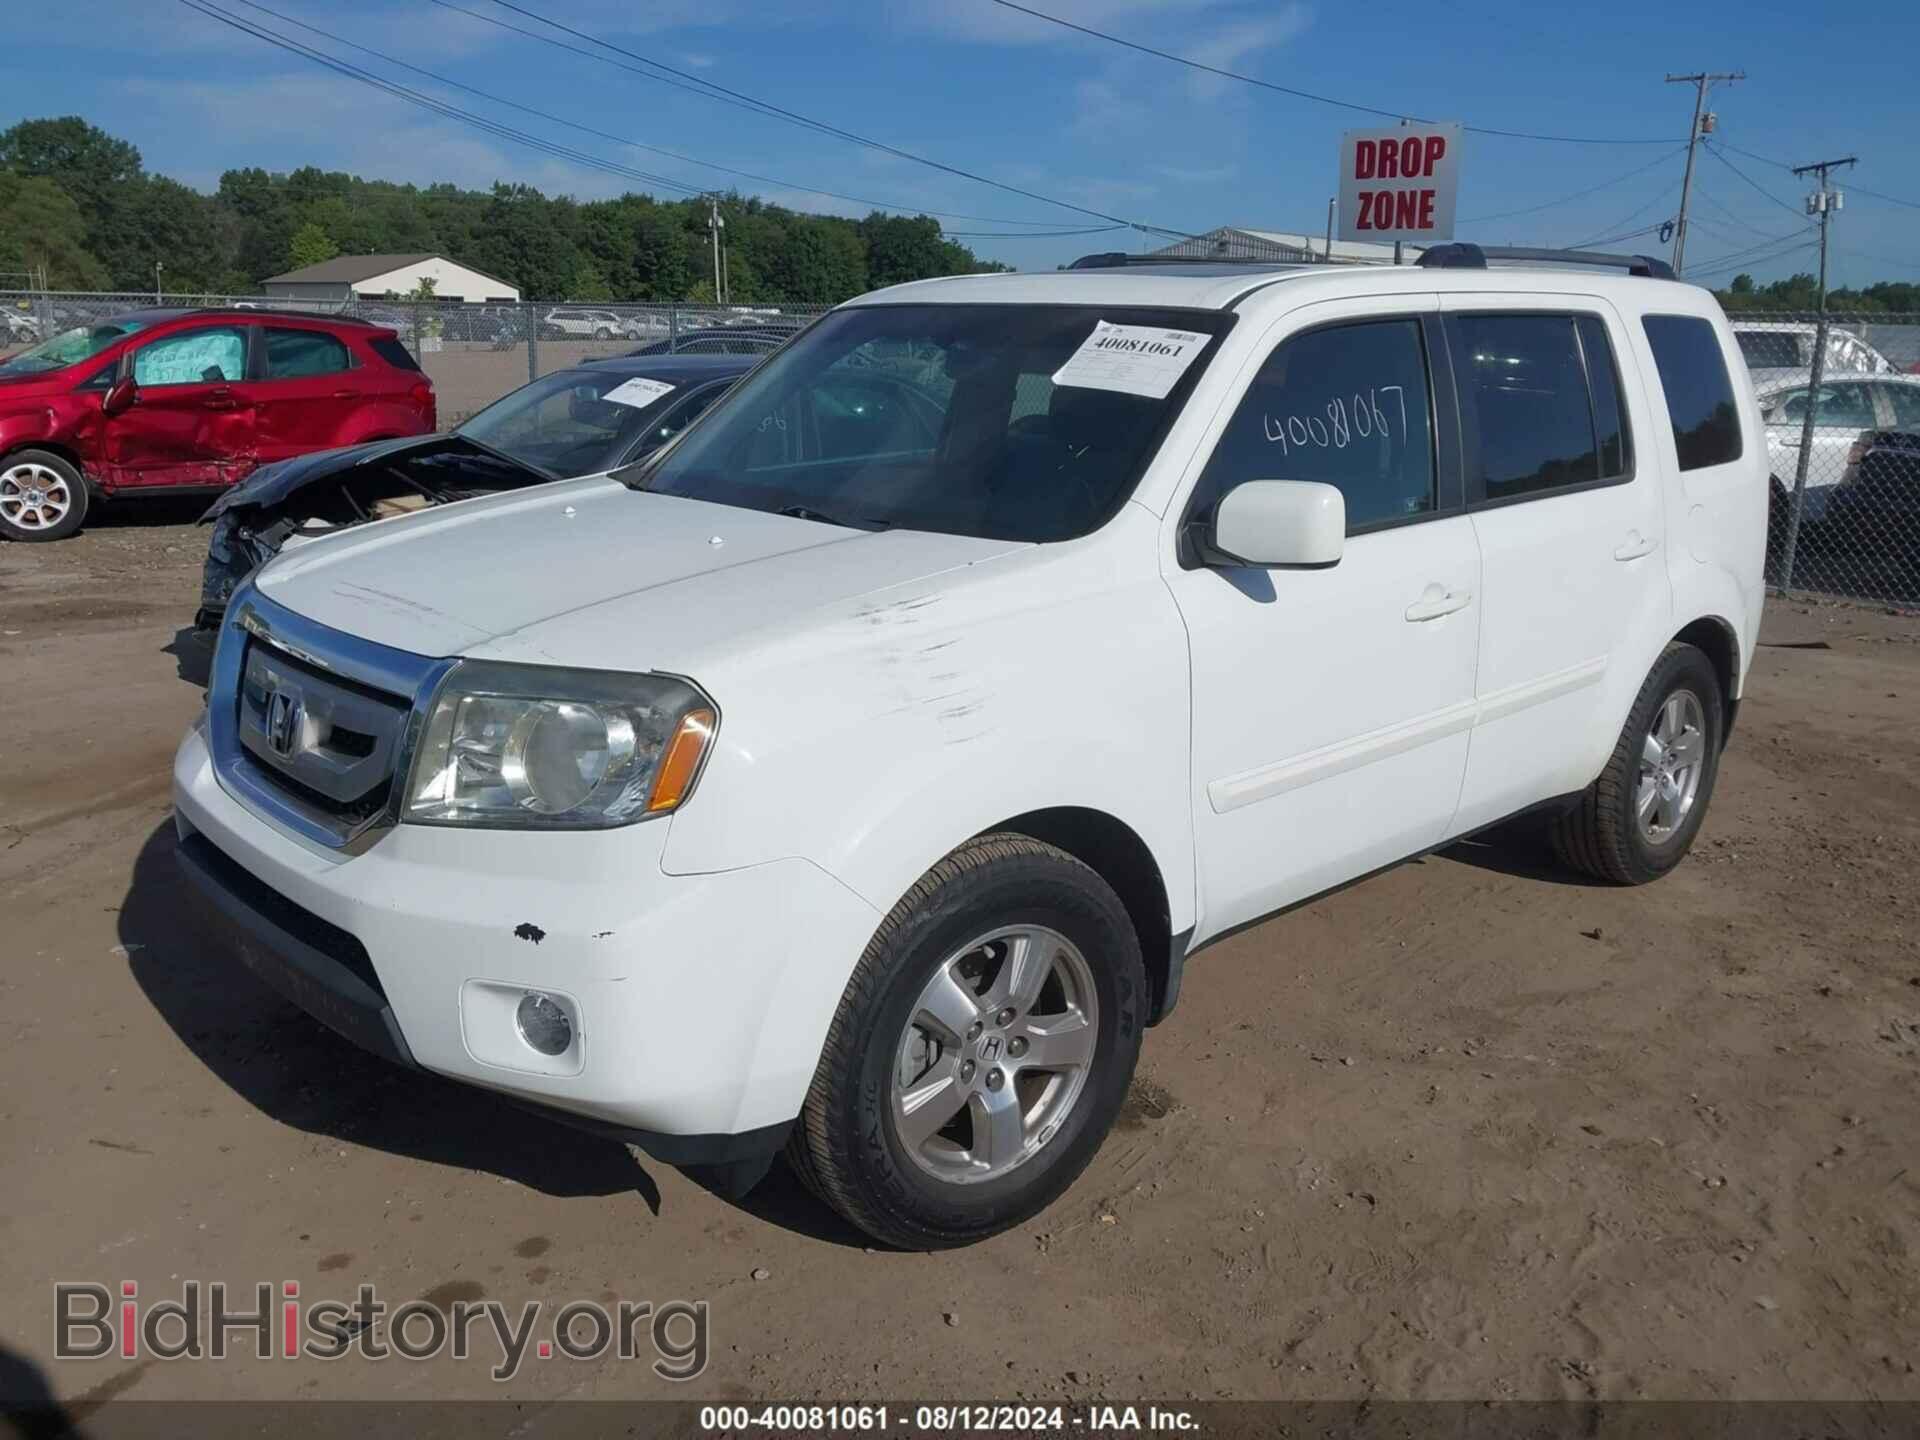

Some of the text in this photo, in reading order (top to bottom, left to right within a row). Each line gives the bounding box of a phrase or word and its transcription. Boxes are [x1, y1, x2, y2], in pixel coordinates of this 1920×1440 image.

[1355, 136, 1446, 180] DROP
[1356, 189, 1436, 230] ZONE
[1094, 335, 1185, 357] 40081061
